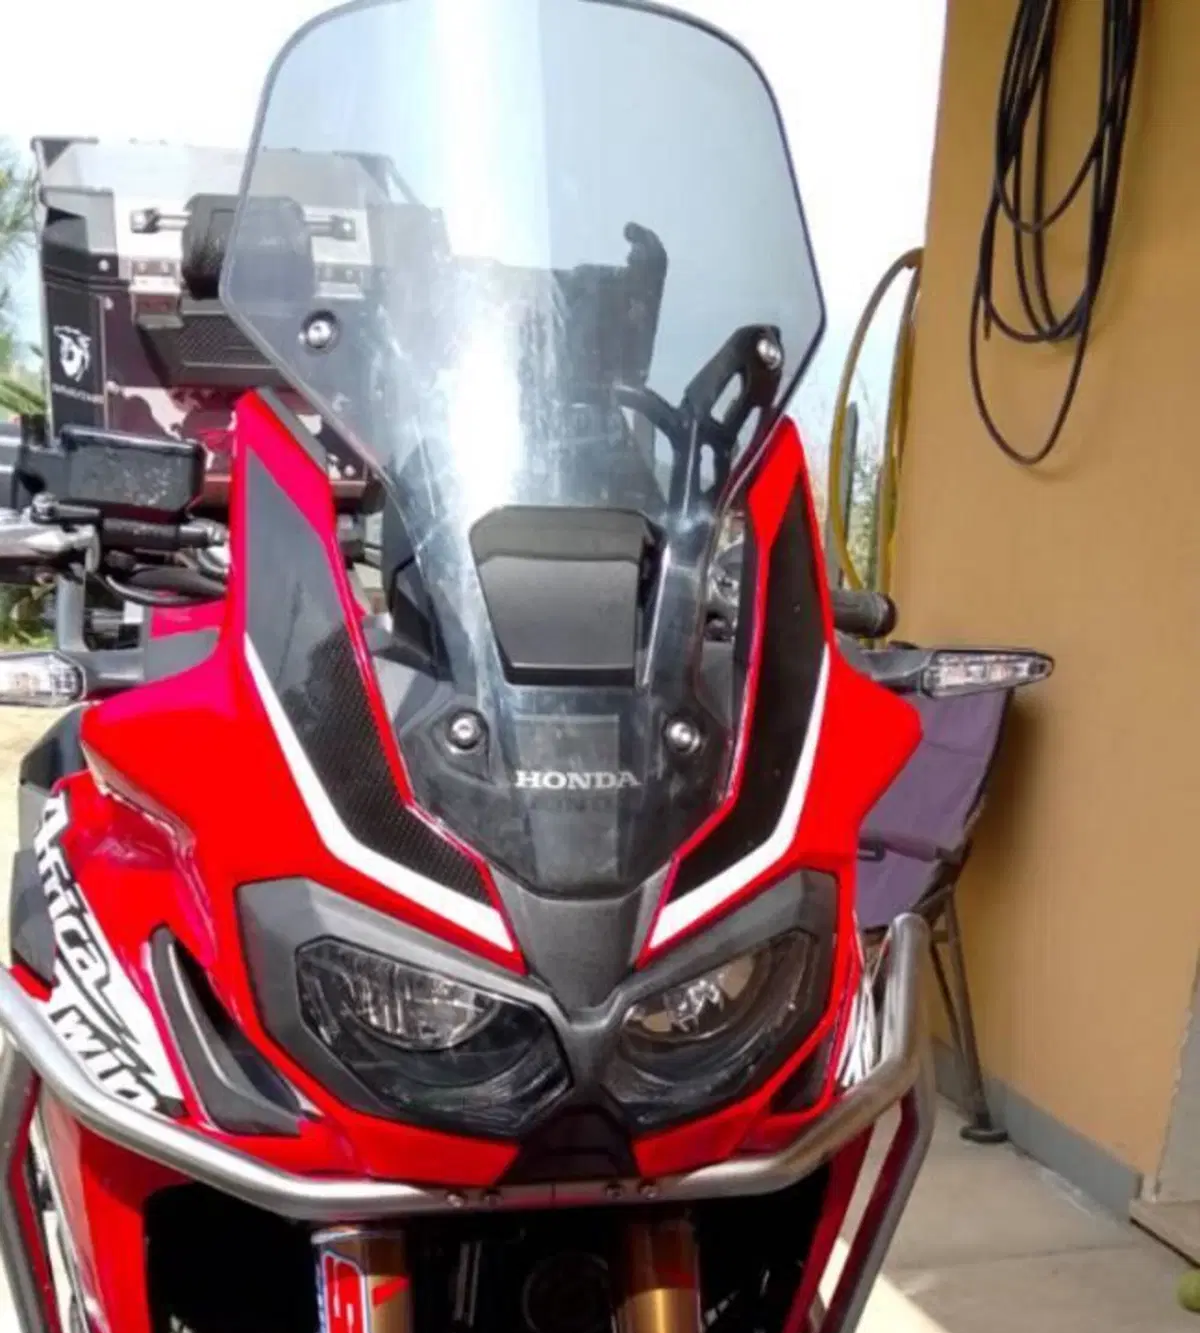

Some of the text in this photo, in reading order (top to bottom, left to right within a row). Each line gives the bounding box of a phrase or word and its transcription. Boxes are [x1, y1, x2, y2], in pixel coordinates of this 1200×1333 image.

[515, 769, 642, 790] HONDA
[34, 792, 113, 990] Africa
[49, 966, 162, 1112] Twin
